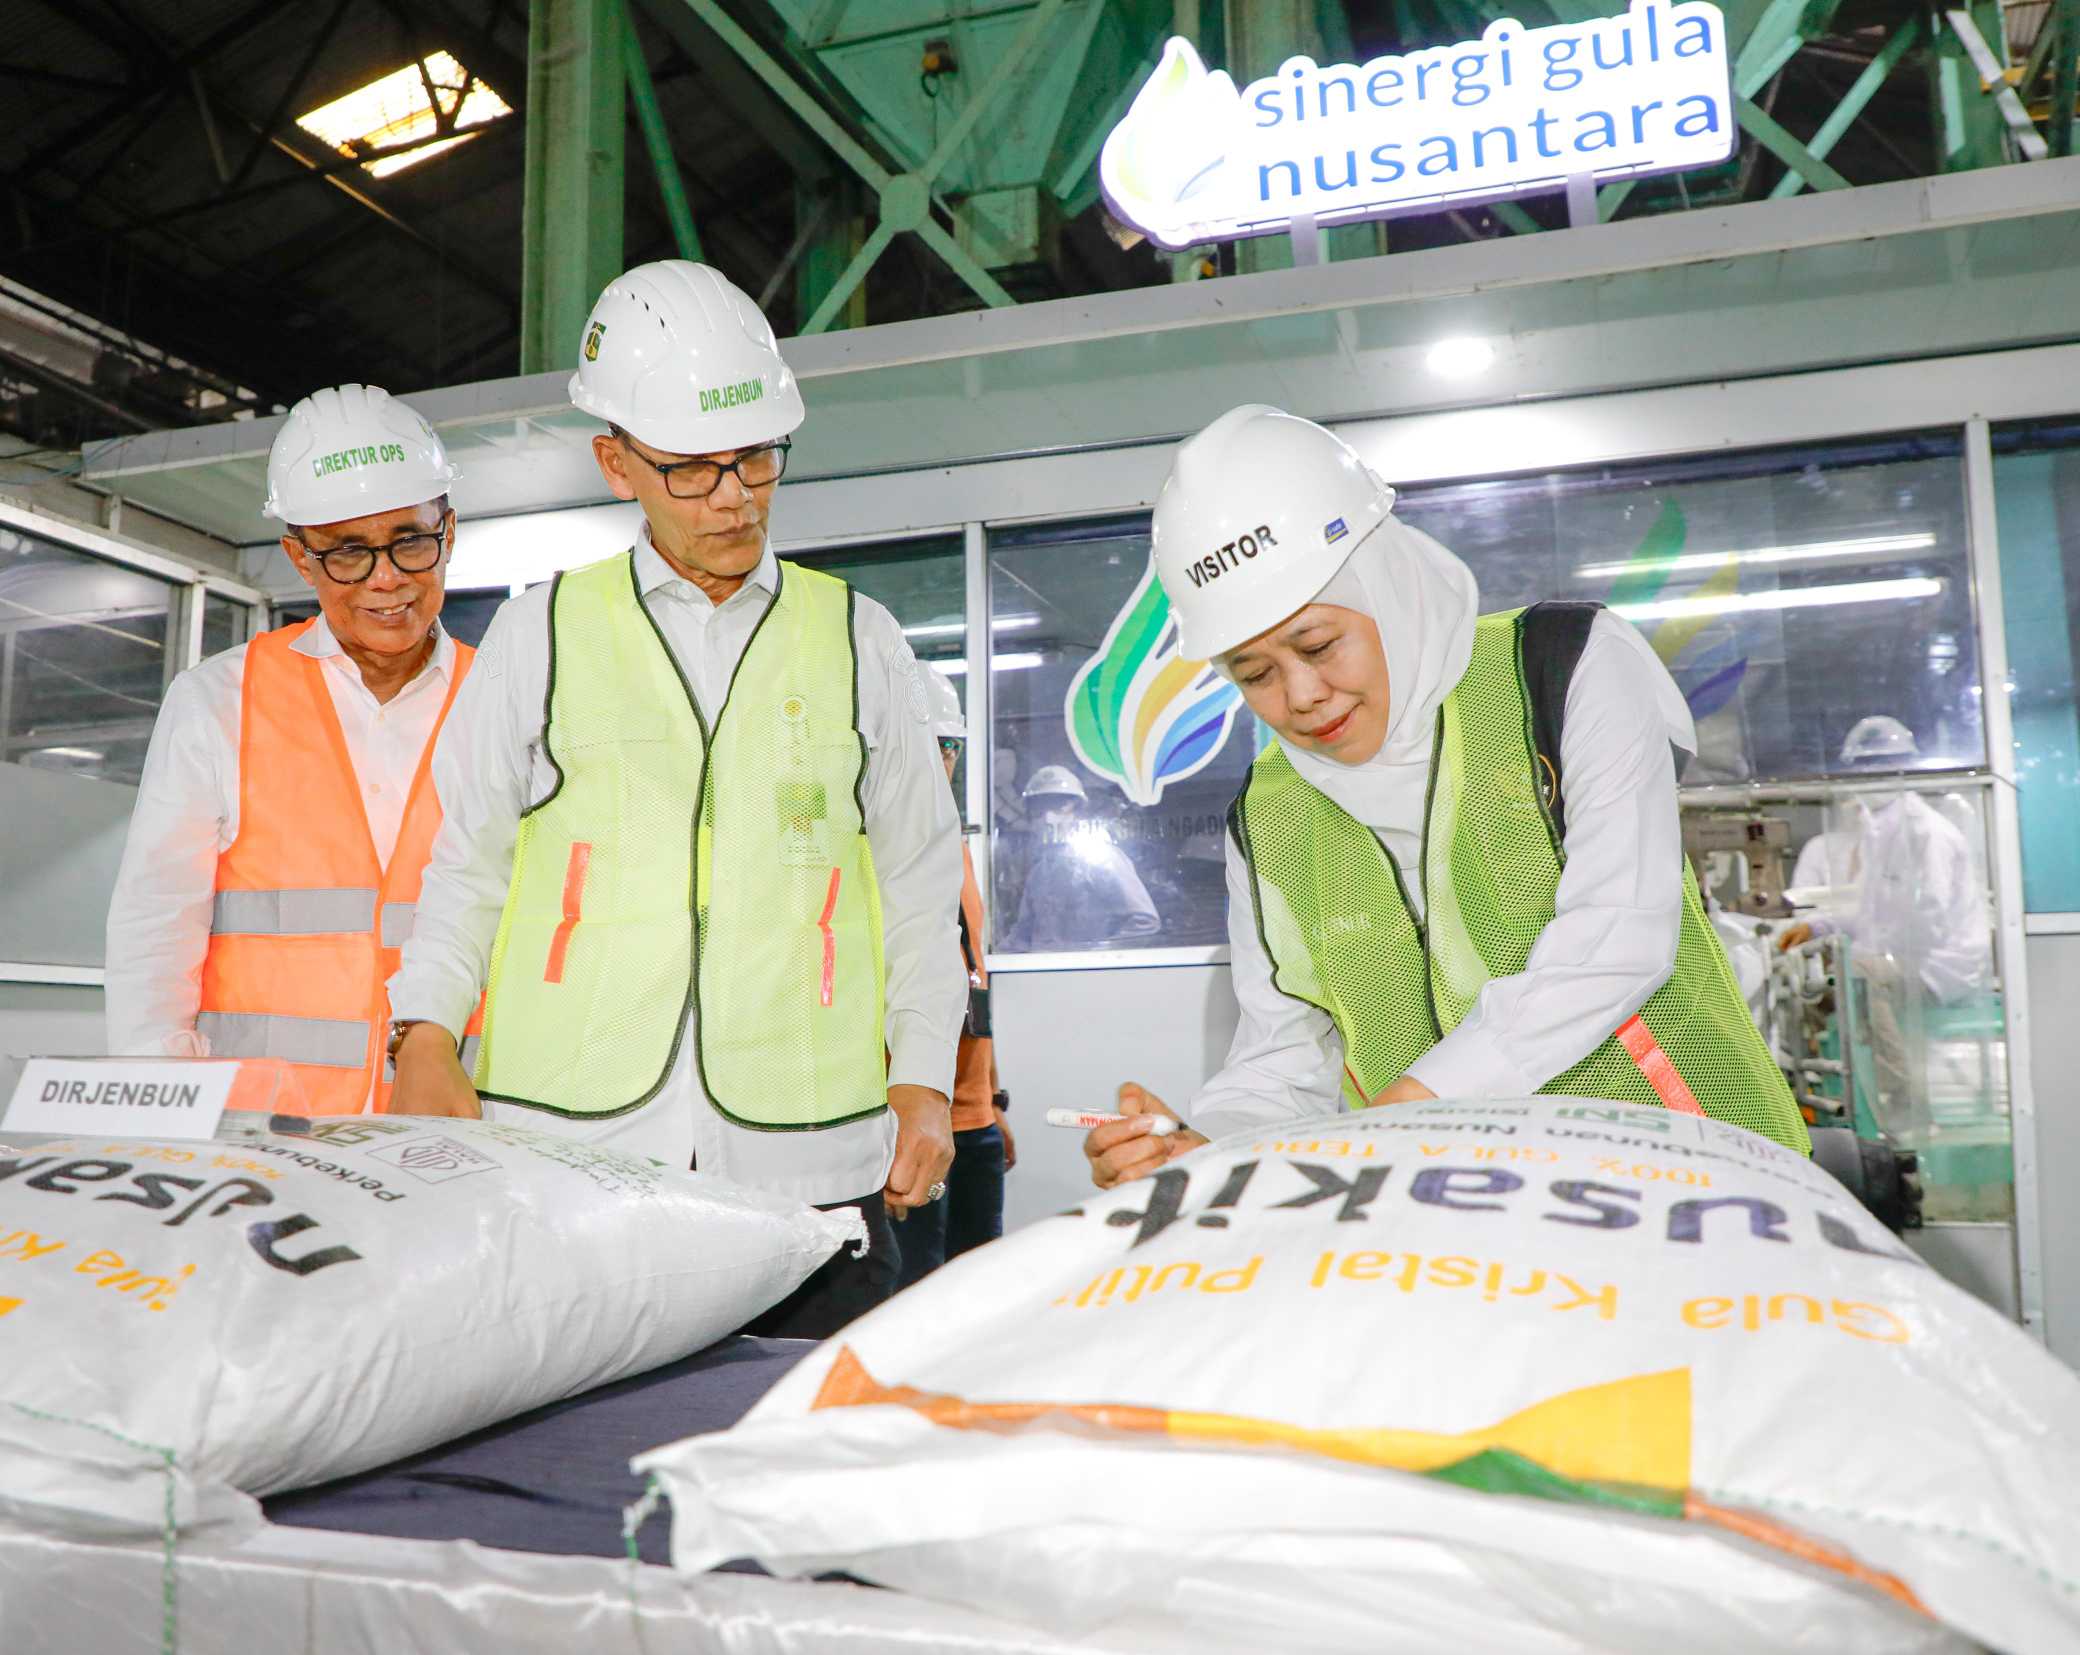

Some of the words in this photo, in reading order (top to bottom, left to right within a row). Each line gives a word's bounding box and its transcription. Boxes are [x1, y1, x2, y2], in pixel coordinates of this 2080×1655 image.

[1253, 31, 1511, 128] sinergi
[1543, 5, 1713, 92] gula
[1258, 94, 1720, 202] nusantara
[699, 378, 763, 412] DIRJENBUN
[312, 446, 378, 478] DIREKTUR
[380, 444, 405, 464] OPS
[1185, 525, 1278, 588] VISITOR
[40, 1079, 201, 1109] DIRJENBUN
[1594, 1154, 1711, 1188] 100%
[1057, 1158, 1927, 1266] nusakit
[1309, 1250, 1620, 1321] Kristal
[1680, 1293, 1911, 1344] Gula
